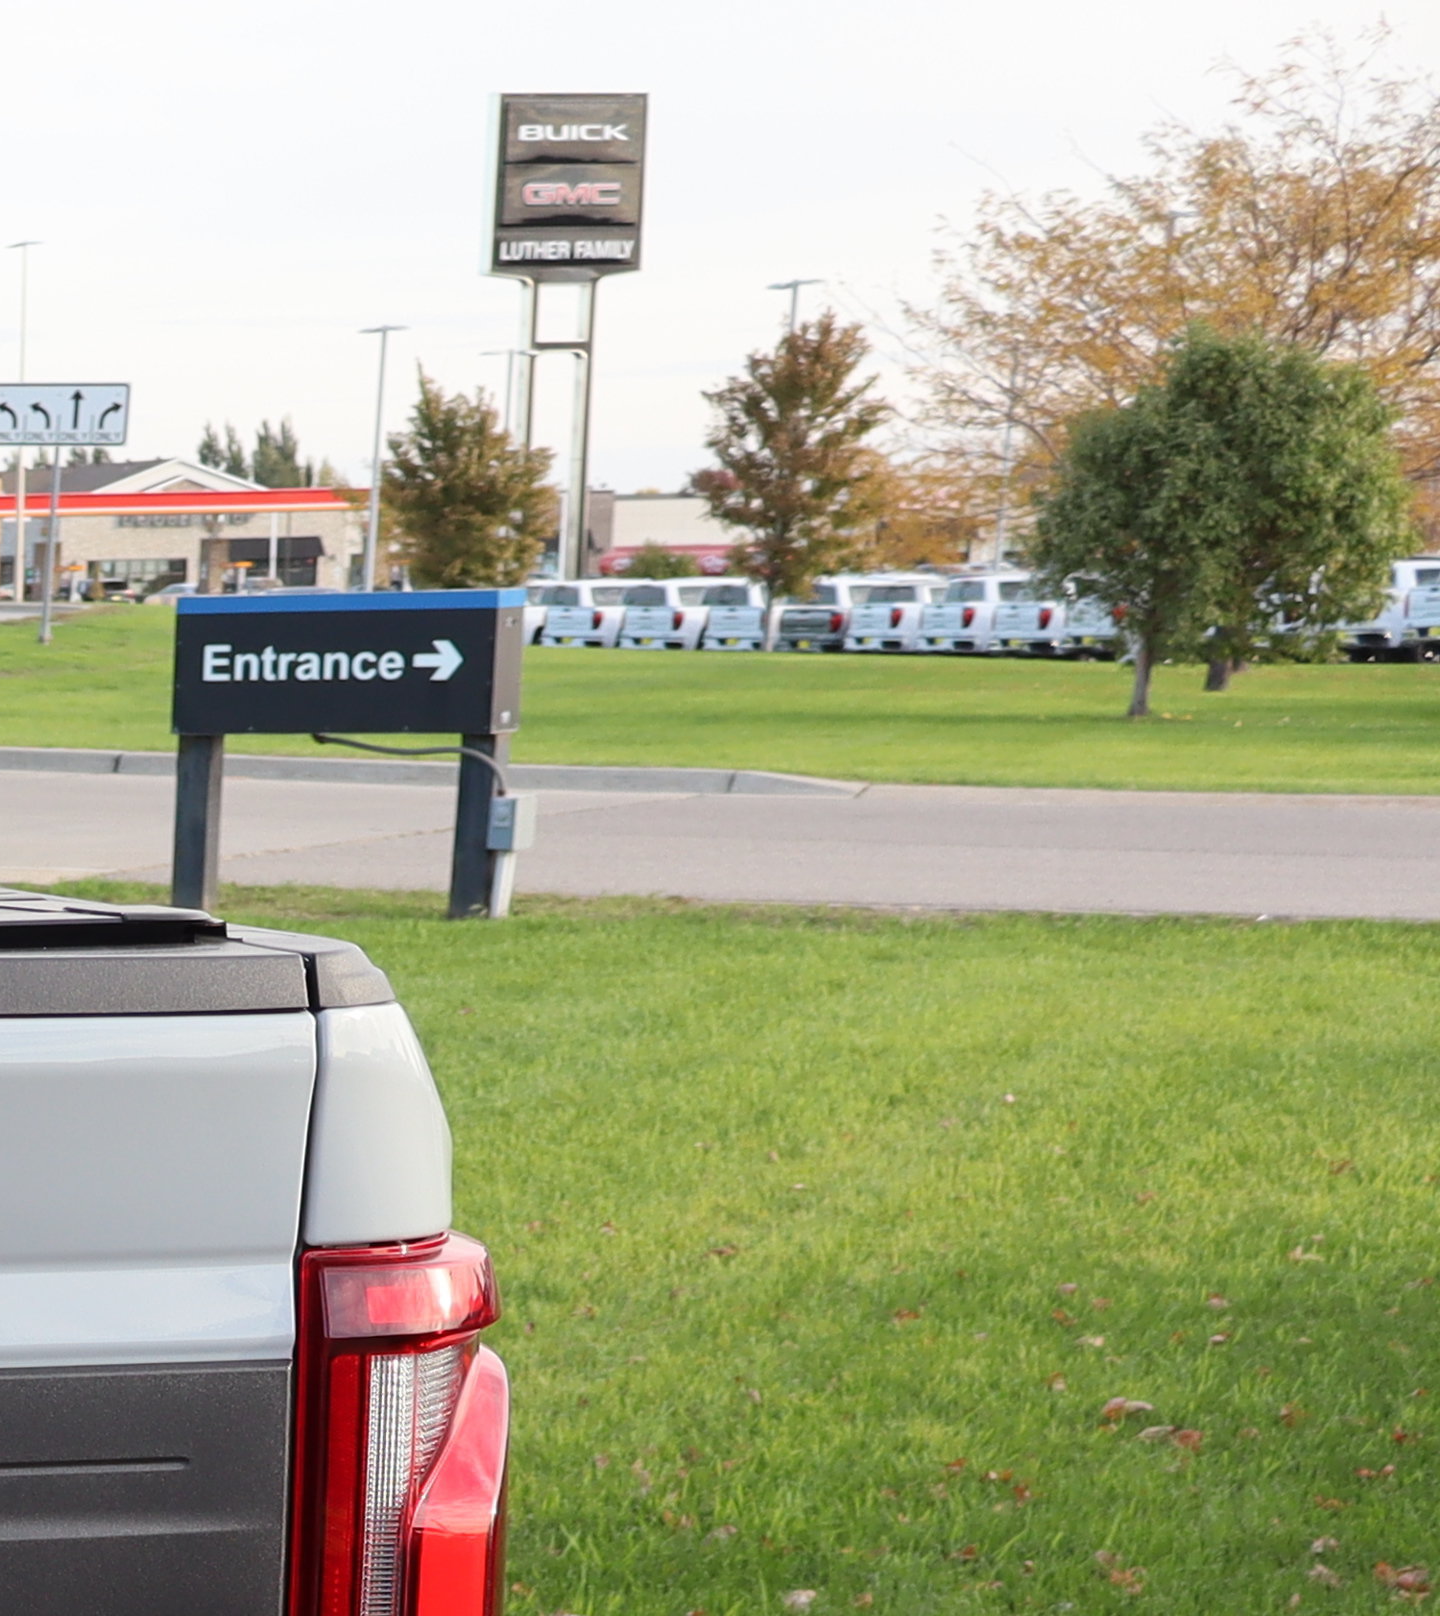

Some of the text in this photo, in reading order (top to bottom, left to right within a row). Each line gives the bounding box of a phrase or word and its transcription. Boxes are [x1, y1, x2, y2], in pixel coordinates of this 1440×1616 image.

[518, 124, 628, 142] BUICK
[522, 182, 621, 205] GMC
[500, 239, 635, 261] LUTHER FAMILY
[202, 642, 405, 682] Entrance
